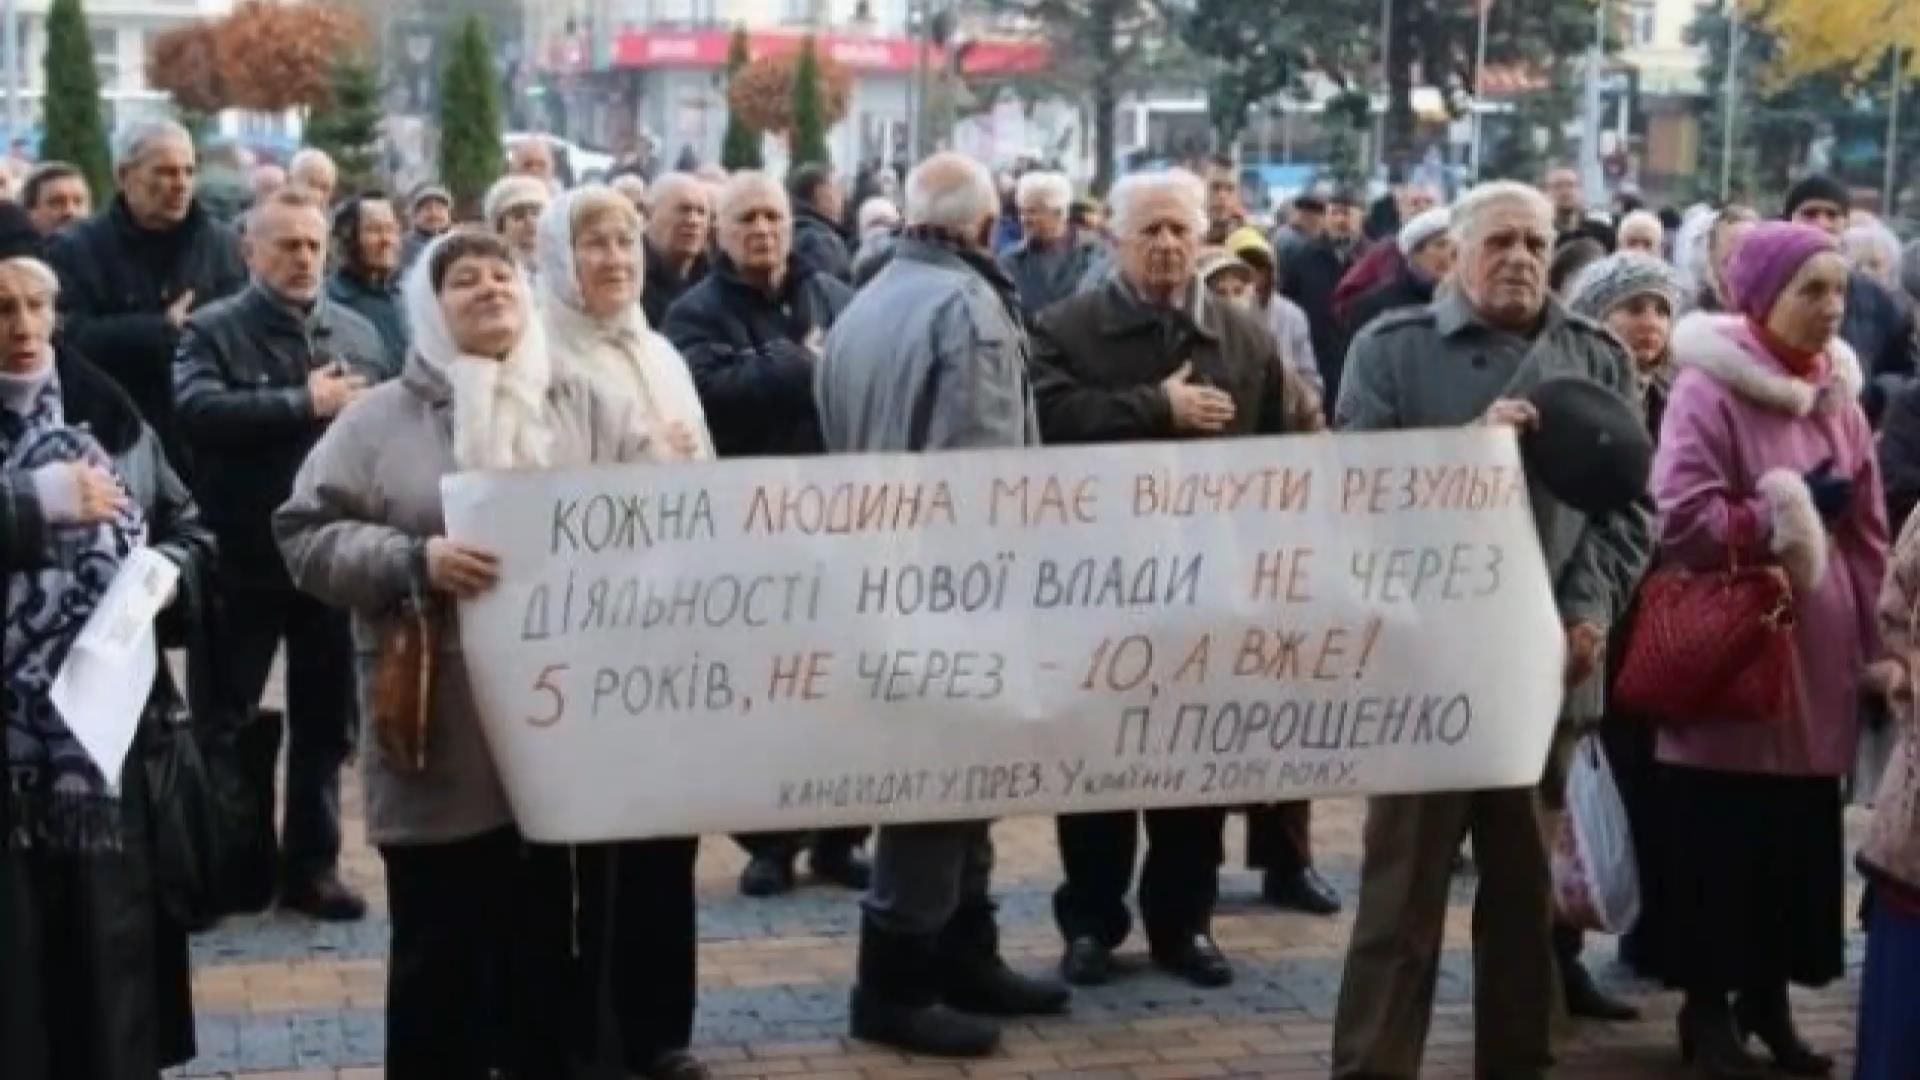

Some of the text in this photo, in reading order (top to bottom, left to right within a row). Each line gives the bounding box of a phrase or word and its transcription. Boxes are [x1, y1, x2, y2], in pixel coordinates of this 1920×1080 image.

[549, 487, 716, 555] КОЖНА
[743, 480, 957, 535] ЛЮДИНА
[989, 475, 1099, 526] МАЄ
[1132, 467, 1313, 518] ВІДЧУТИ
[520, 543, 1504, 642] ДІЯЛЬНОСТІ НОВОЇ ВЛАДИ НЕ ЧЕРЕЗ
[525, 662, 570, 728] 5
[590, 651, 752, 720] РОКІВ,
[767, 650, 834, 704] НЕ
[857, 649, 1006, 703] ЧЕРЕЗ
[1173, 633, 1212, 684] А
